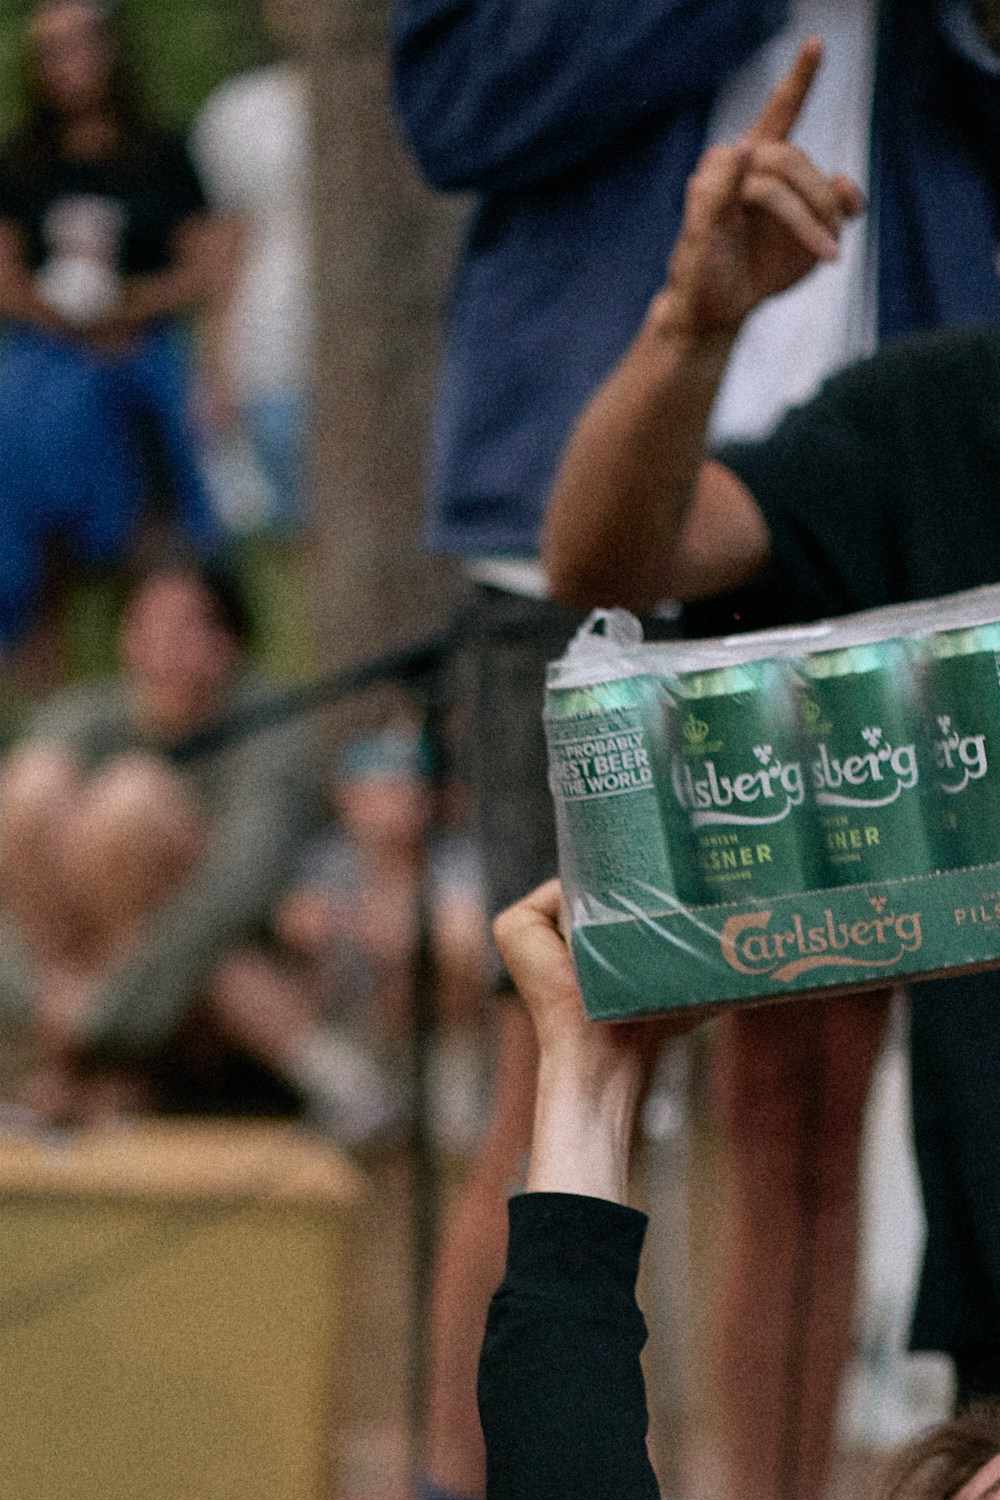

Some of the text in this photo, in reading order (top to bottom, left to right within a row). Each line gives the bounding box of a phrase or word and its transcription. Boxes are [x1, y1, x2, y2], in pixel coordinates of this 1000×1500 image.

[558, 748, 650, 780] EST BEER
[587, 767, 653, 793] WORLD
[720, 897, 923, 983] Carlsberg
